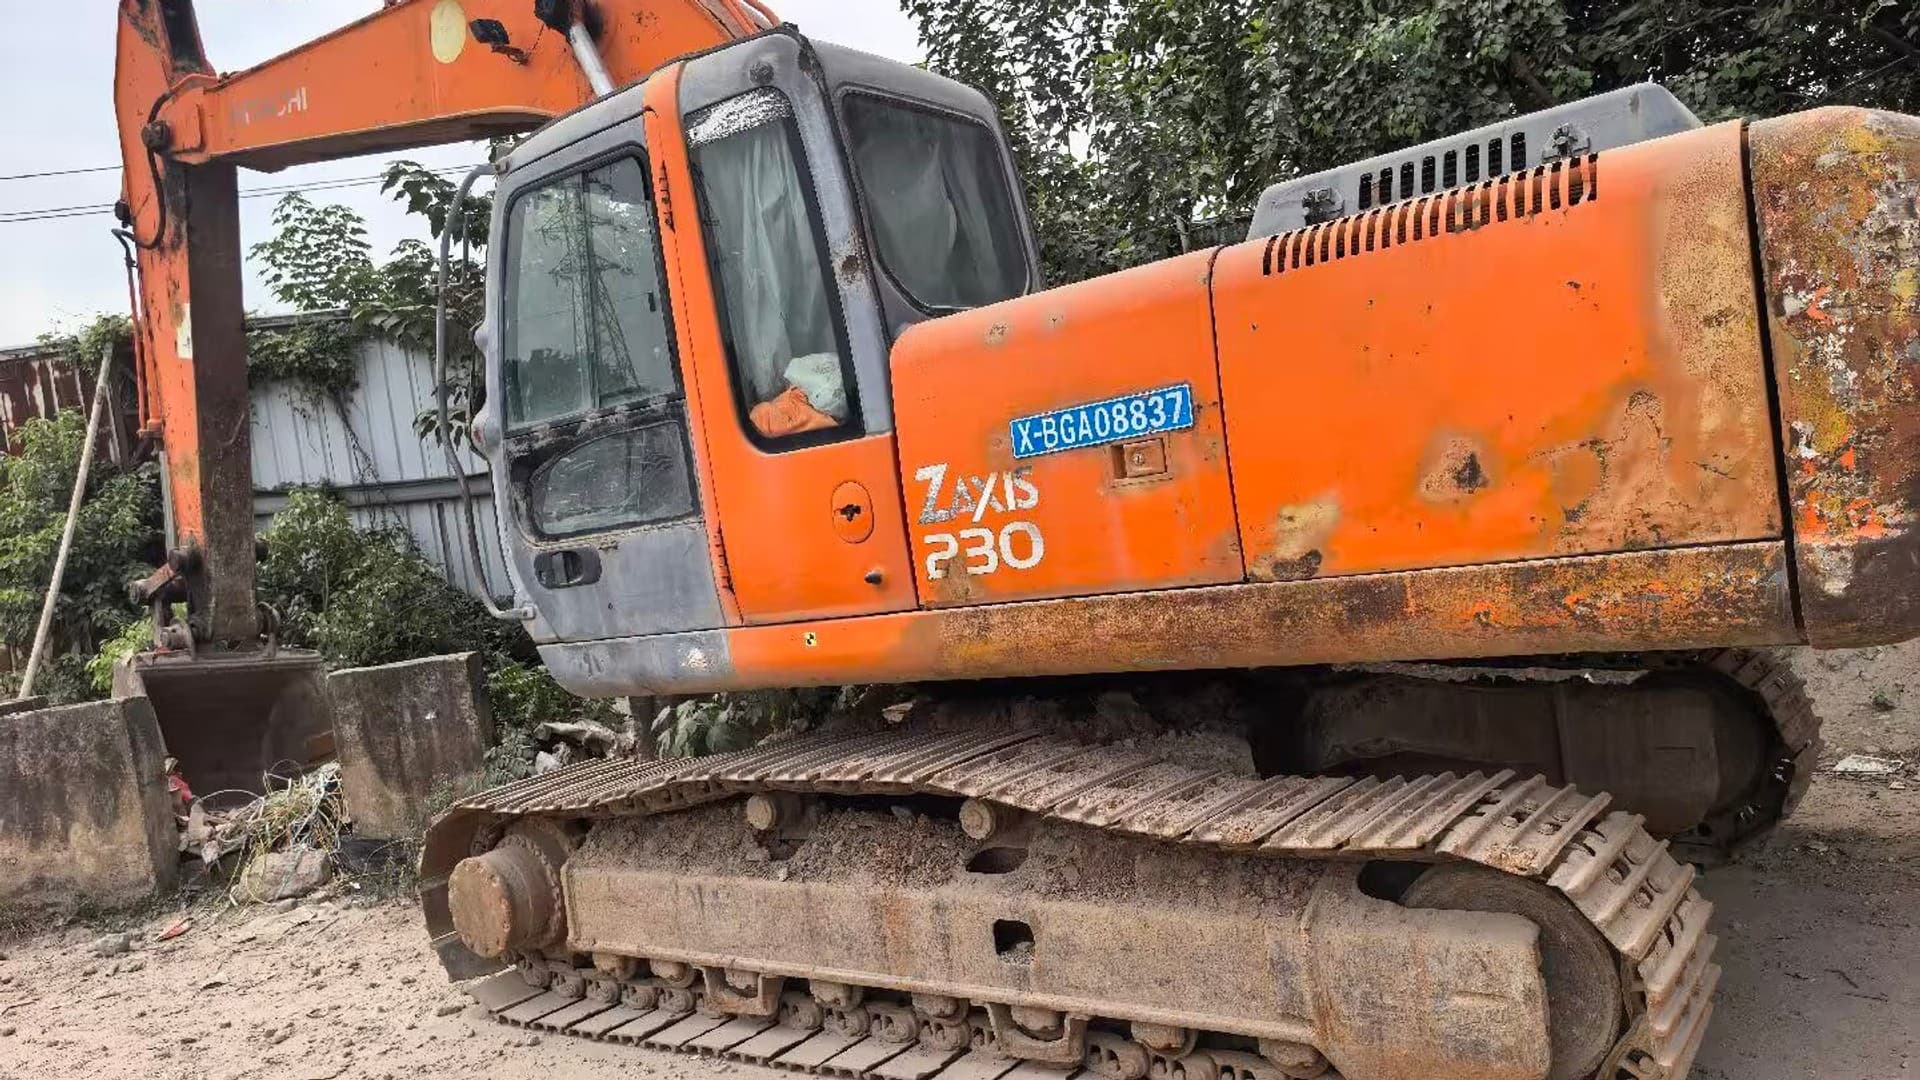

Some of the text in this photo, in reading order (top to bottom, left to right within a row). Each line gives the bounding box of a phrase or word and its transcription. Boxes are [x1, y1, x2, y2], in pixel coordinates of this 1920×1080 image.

[1018, 391, 1184, 453] X-BGA08837
[915, 463, 1040, 524] ZAXIS
[924, 521, 1045, 580] 230
